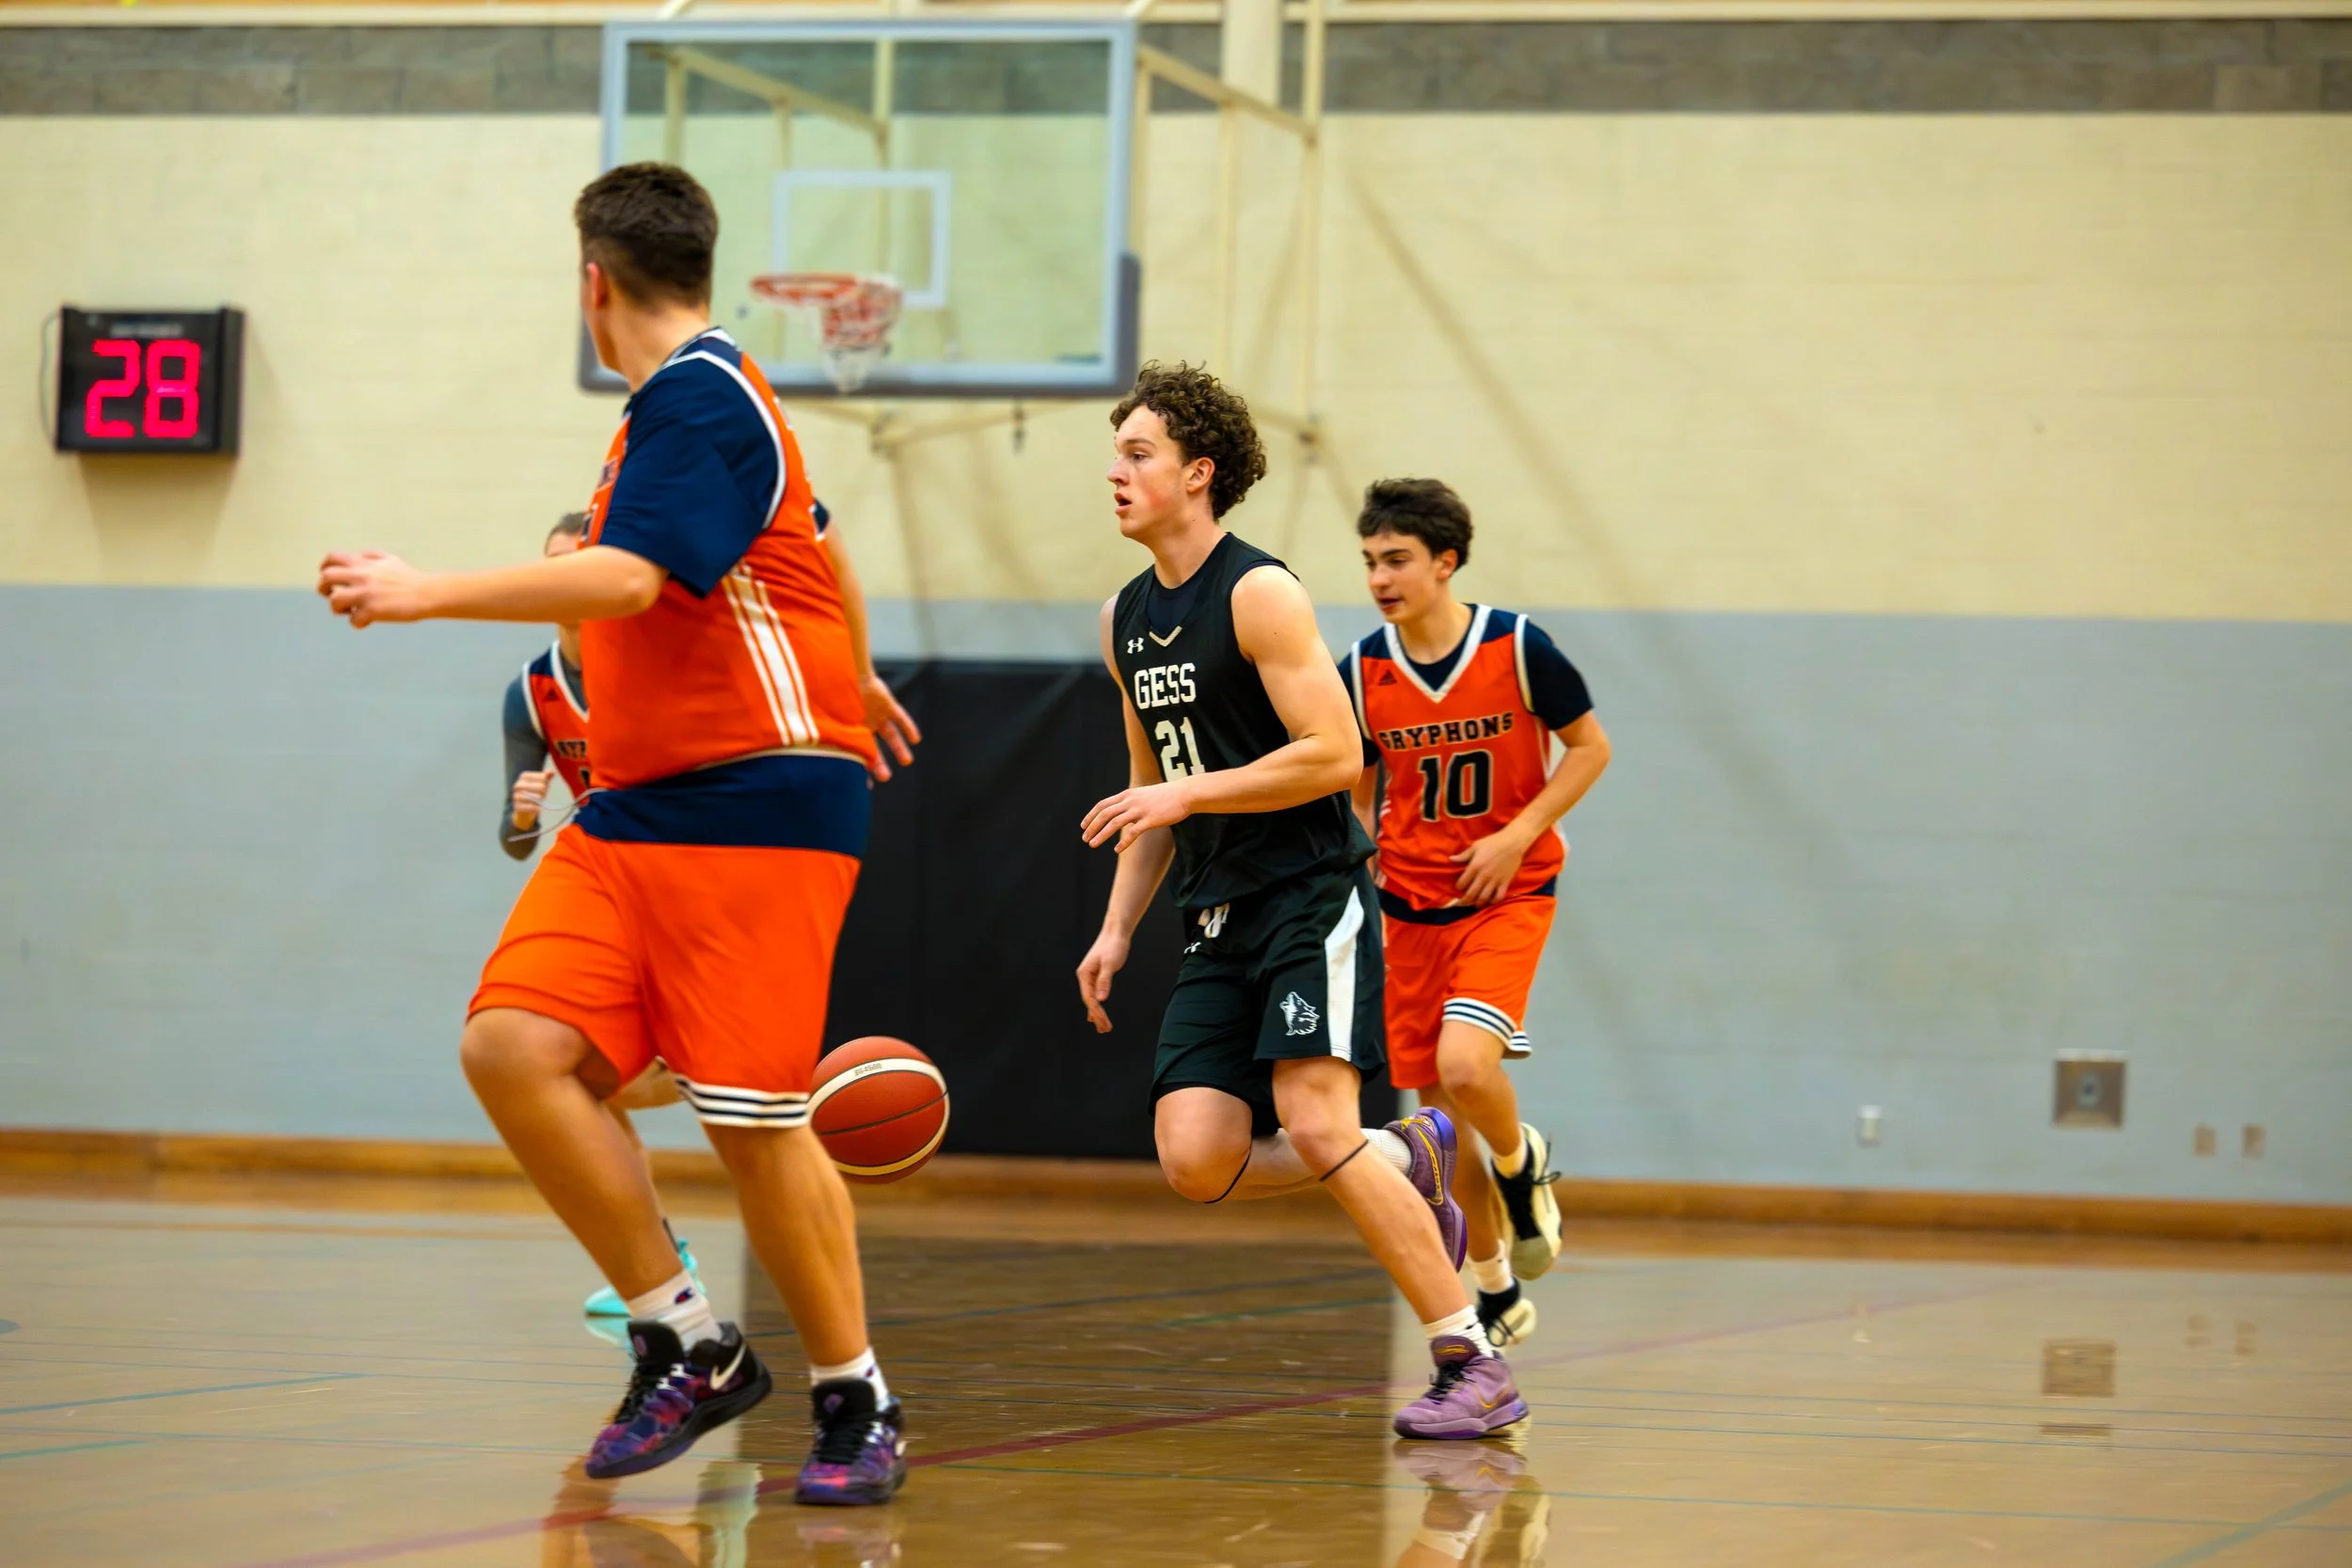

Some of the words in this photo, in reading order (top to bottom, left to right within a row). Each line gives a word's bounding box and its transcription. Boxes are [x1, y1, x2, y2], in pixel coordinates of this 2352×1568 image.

[85, 339, 201, 438] 28
[1134, 662, 1197, 710] GESS
[1154, 716, 1206, 783] 21
[1418, 749, 1494, 823] 10
